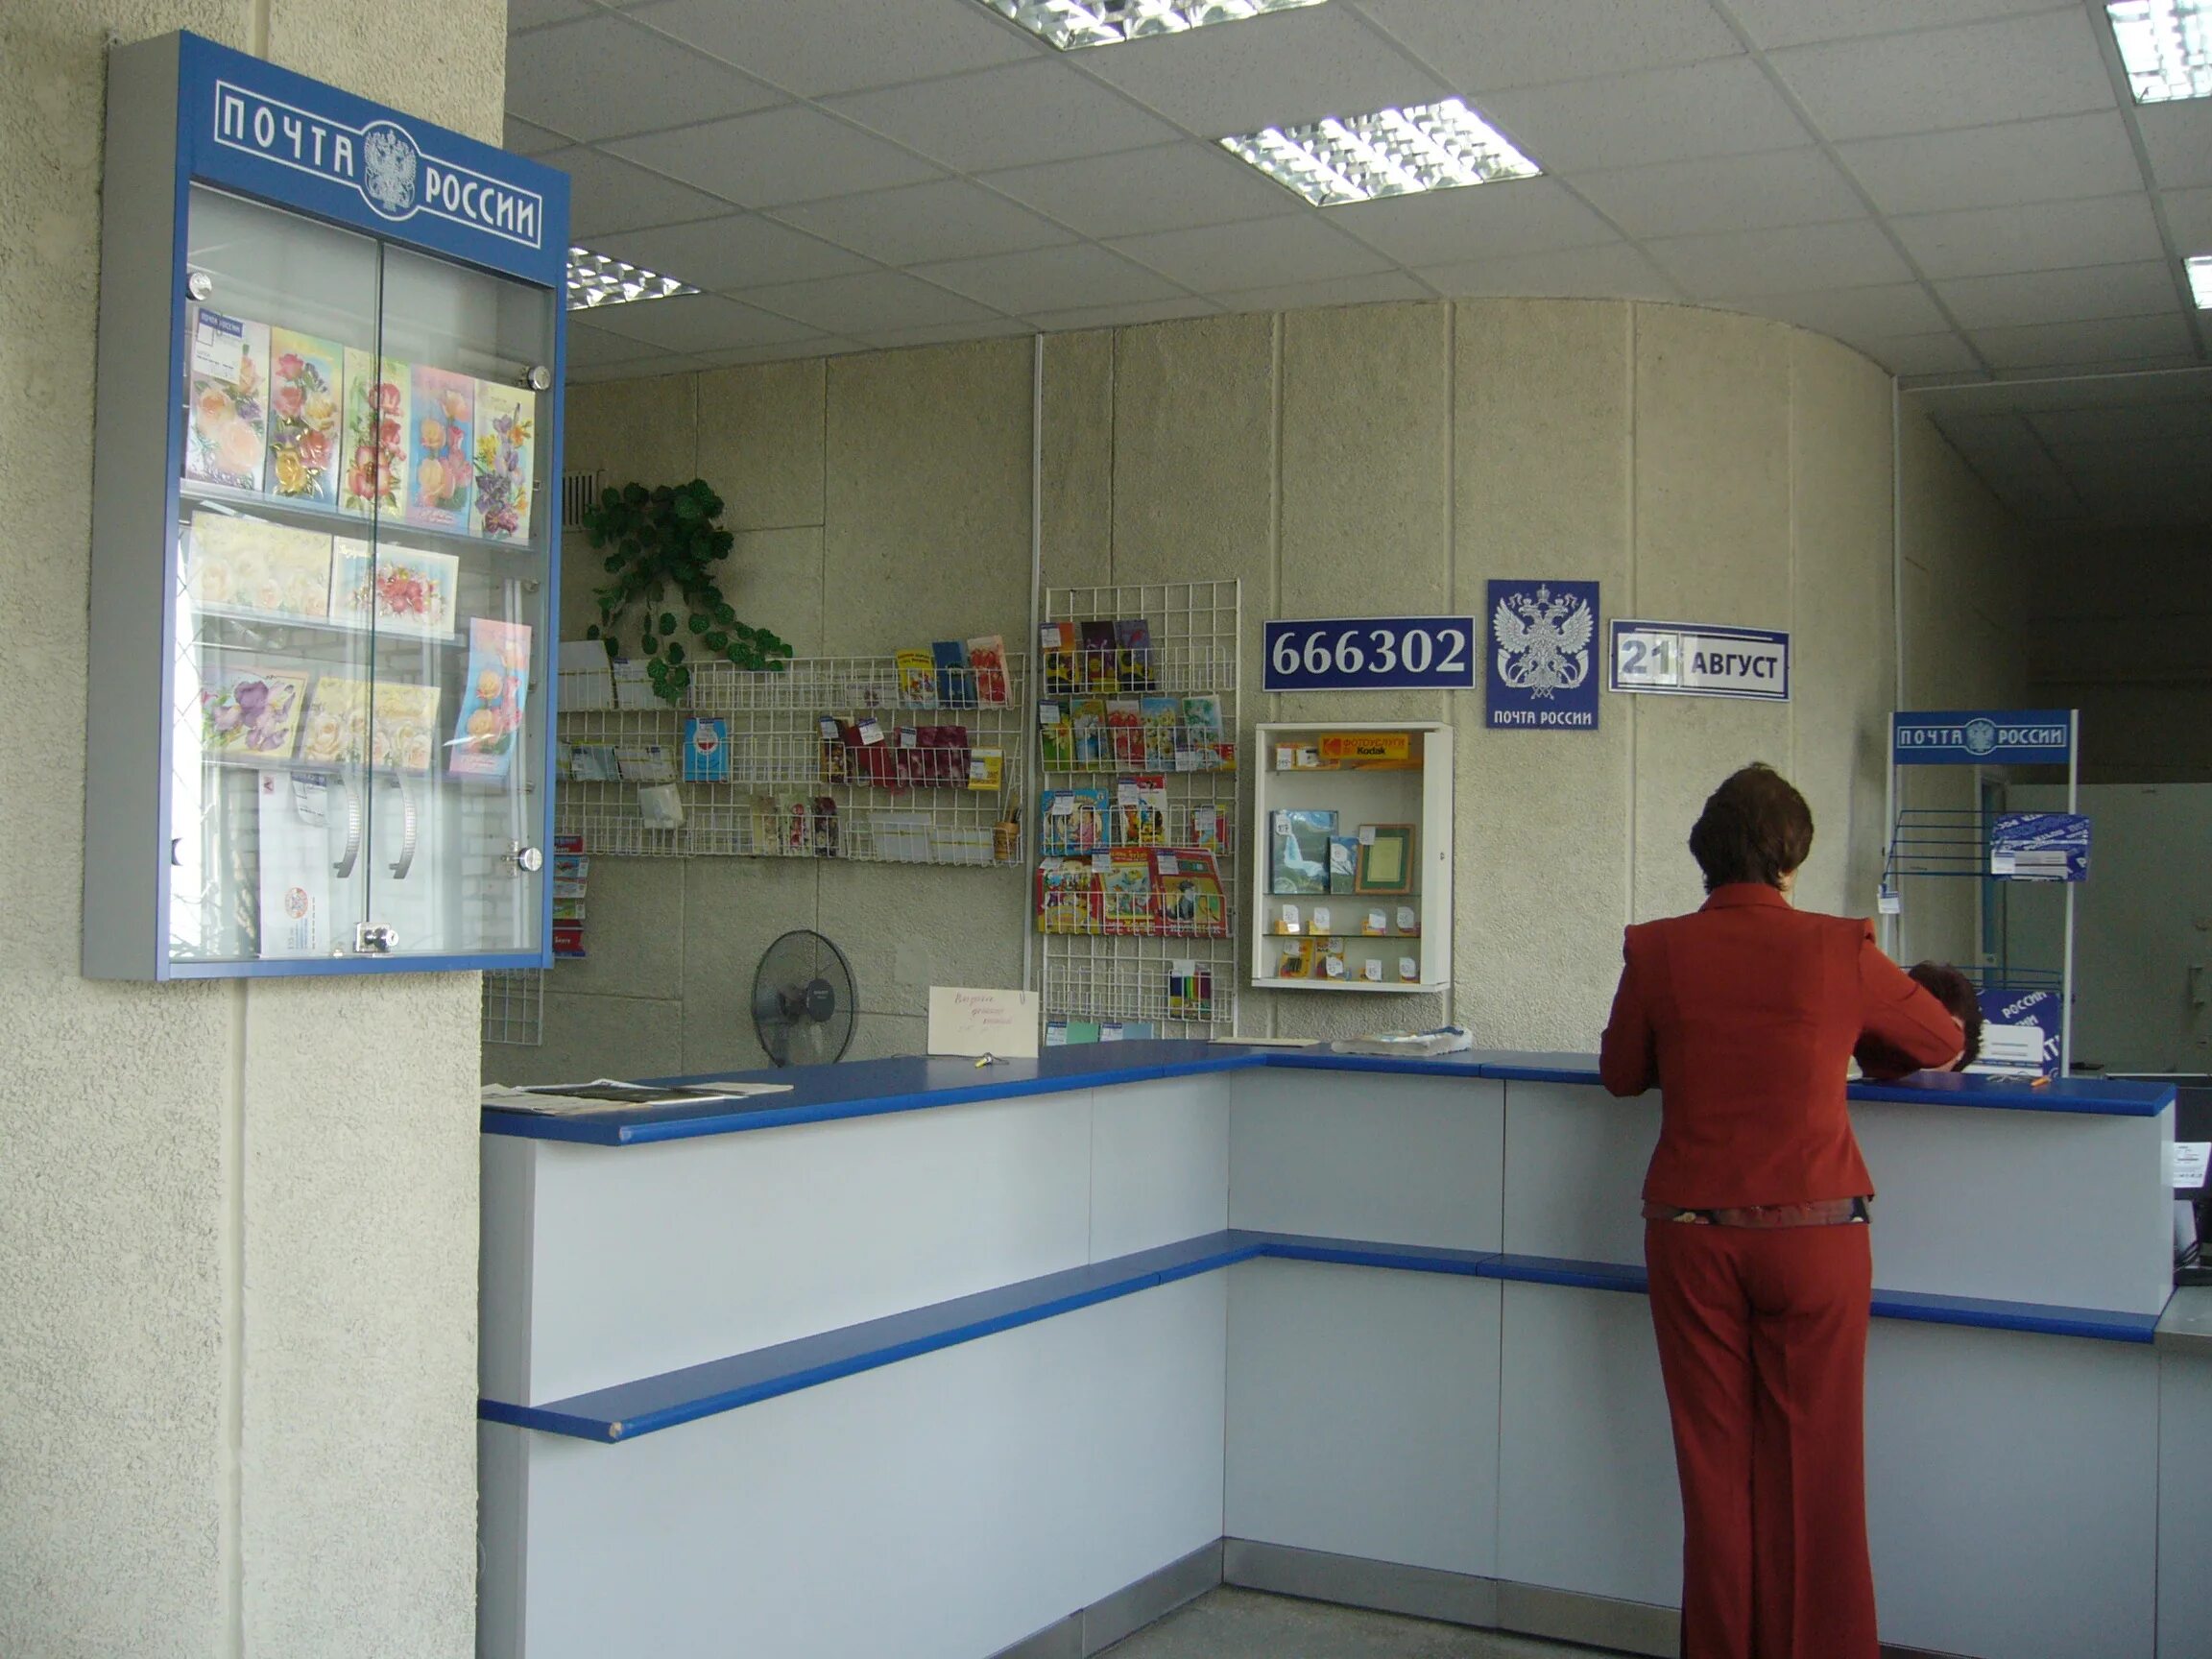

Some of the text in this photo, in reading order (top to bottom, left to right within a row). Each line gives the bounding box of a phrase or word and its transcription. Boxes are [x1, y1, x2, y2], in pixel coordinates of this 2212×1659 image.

[223, 93, 535, 238] ПОЧТА РОССИИ
[1271, 629, 1467, 676] 666302
[1621, 638, 1778, 680] 21 АВГУСТ
[1493, 710, 1593, 726] ПОЧТА РОССИИ
[1343, 737, 1406, 747] ФОТОУСЛУГИ
[1901, 729, 2063, 746] ПОЧТА РОССИИ
[1357, 746, 1386, 755] Kodak
[2001, 991, 2048, 1019] РОССИИ
